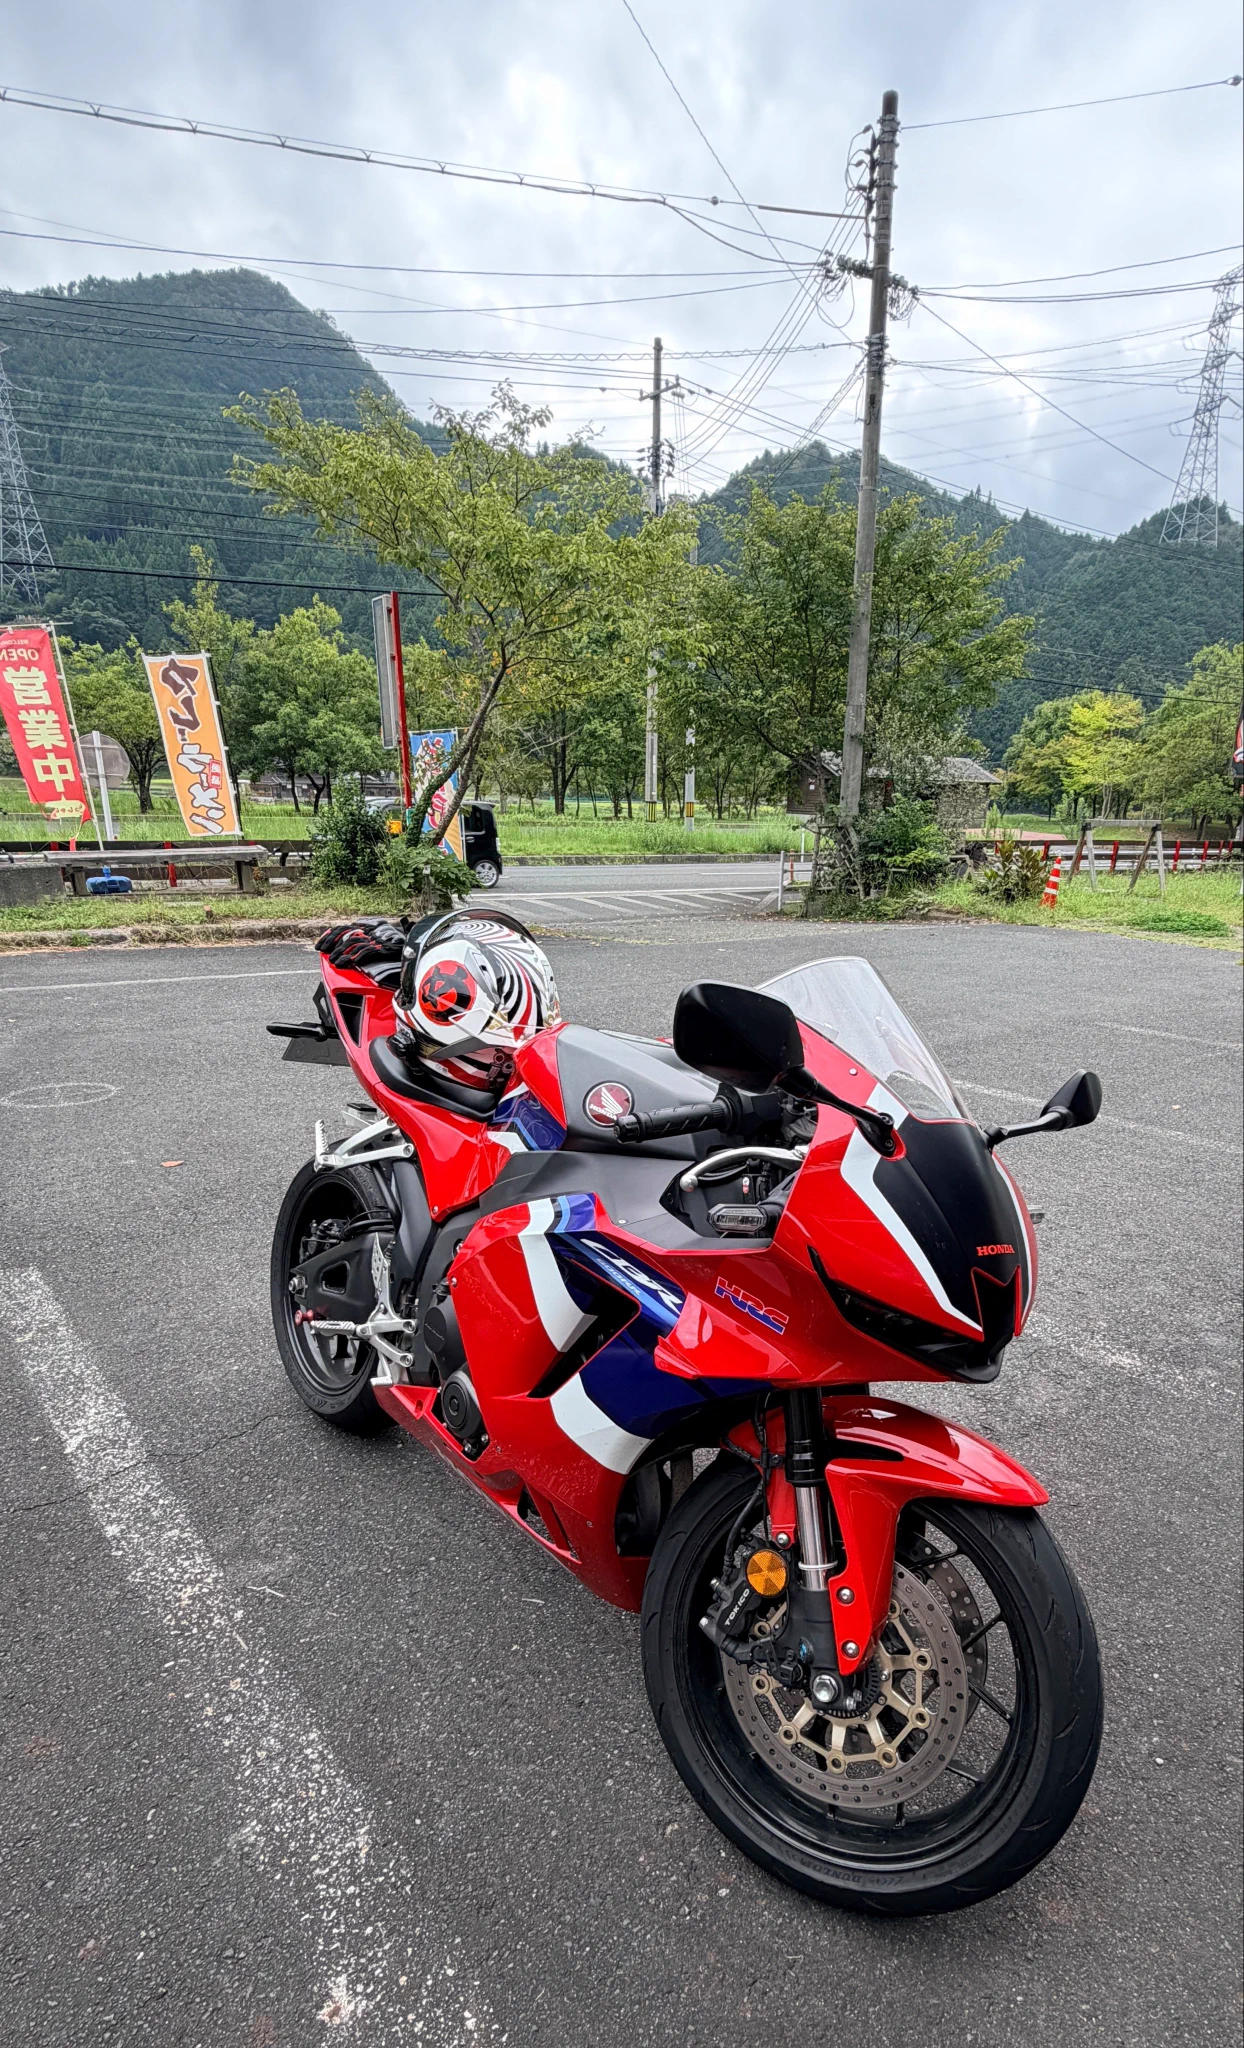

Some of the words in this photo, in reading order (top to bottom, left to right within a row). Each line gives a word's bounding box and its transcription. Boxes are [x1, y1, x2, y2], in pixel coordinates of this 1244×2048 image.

[589, 1103, 617, 1121] HONDA
[976, 1244, 1015, 1256] HONDA
[580, 1238, 683, 1315] CBR
[714, 1276, 789, 1335] HRC
[724, 1588, 750, 1627] TOKICO
[799, 1858, 863, 1884] DUNLOP
